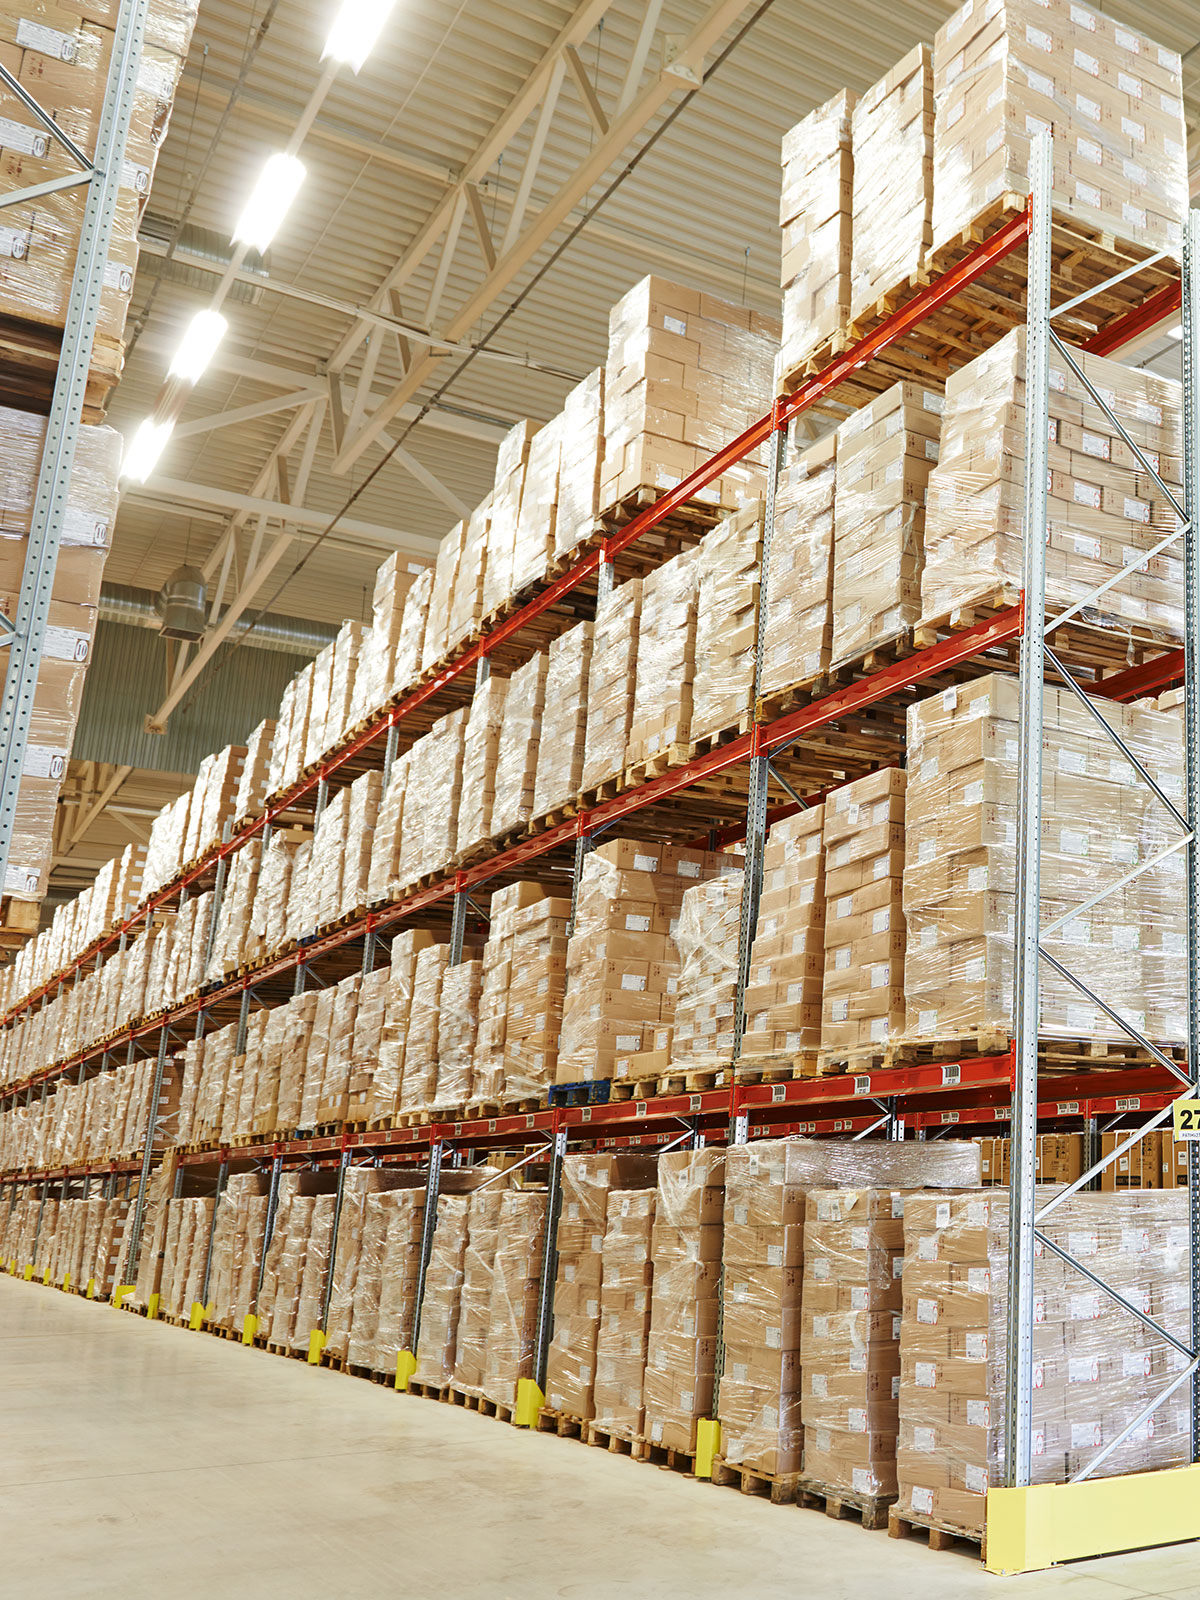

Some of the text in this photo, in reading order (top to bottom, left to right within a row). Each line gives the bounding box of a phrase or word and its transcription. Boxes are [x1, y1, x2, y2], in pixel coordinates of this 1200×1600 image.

[36, 140, 45, 153] 10
[138, 175, 147, 187] 10
[121, 275, 131, 287] 10
[96, 527, 106, 540] 10
[77, 644, 87, 657] 10
[53, 760, 63, 773] 10
